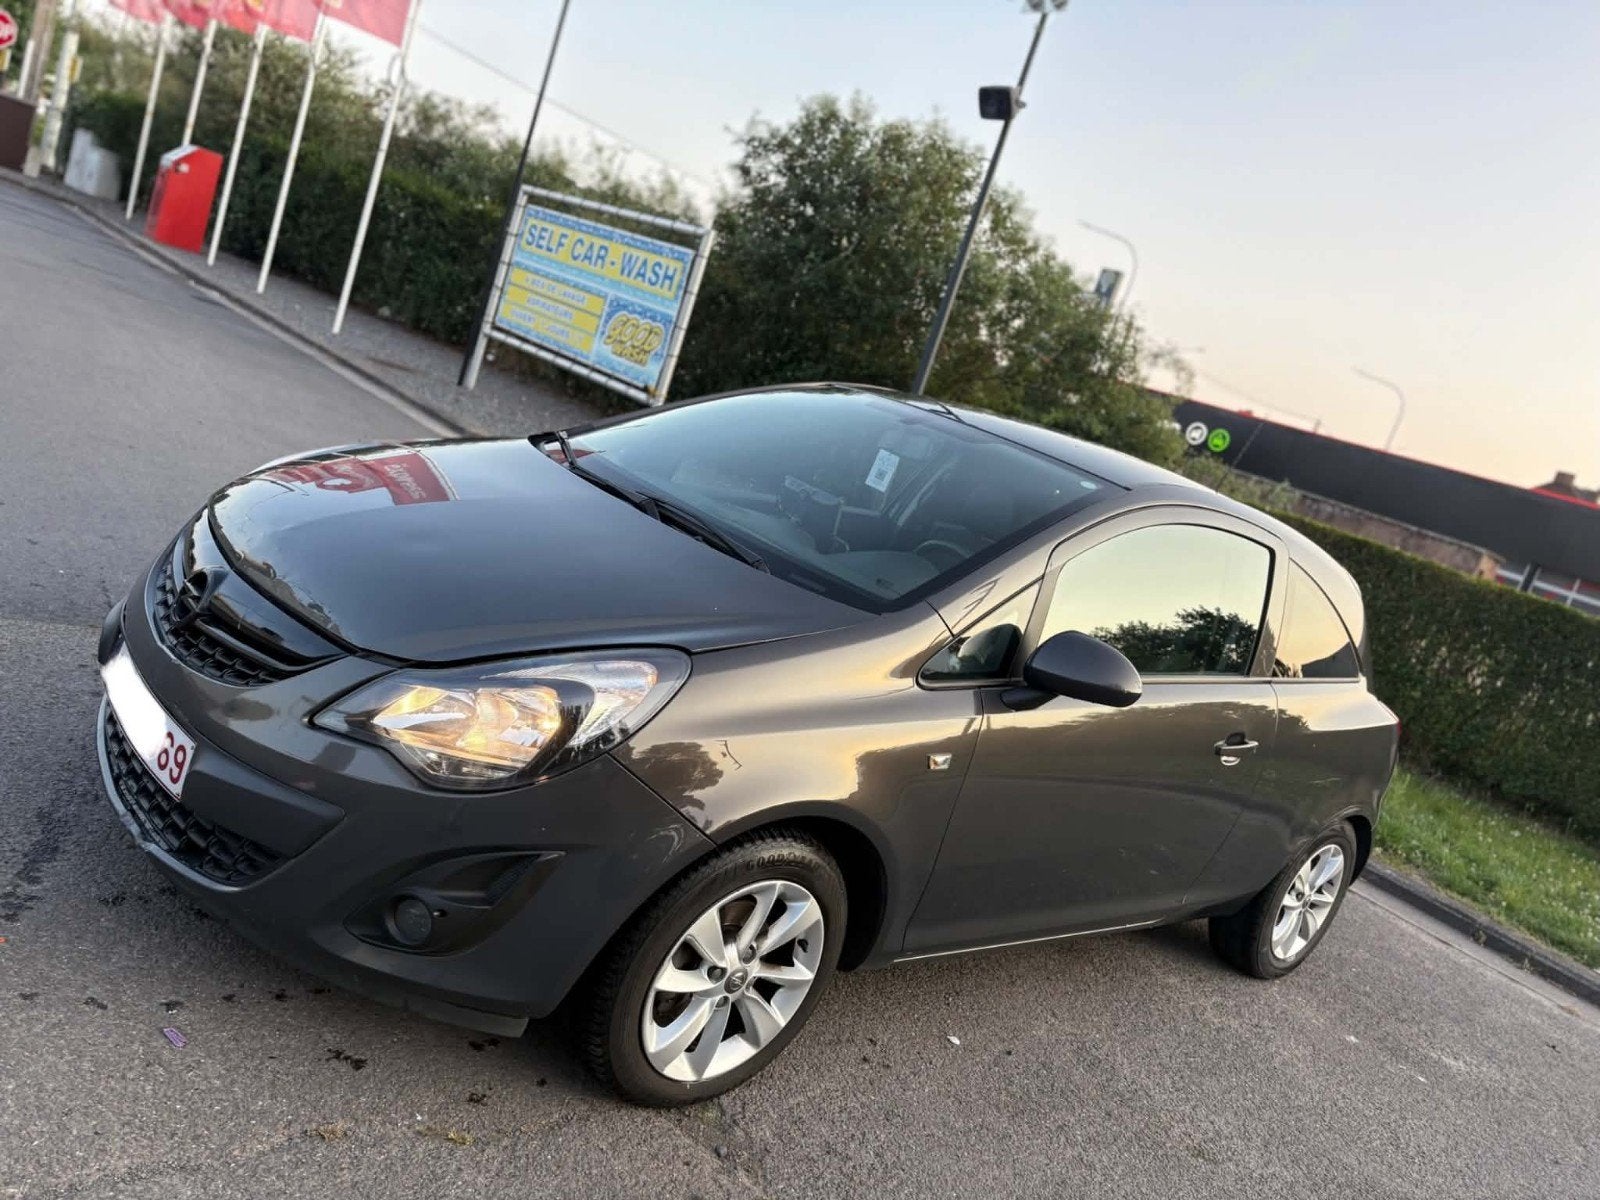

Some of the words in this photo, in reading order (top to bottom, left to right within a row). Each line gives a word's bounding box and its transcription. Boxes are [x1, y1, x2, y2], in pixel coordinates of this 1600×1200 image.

[525, 224, 569, 255] SELF
[571, 236, 609, 270] CAR
[620, 251, 678, 292] WASH
